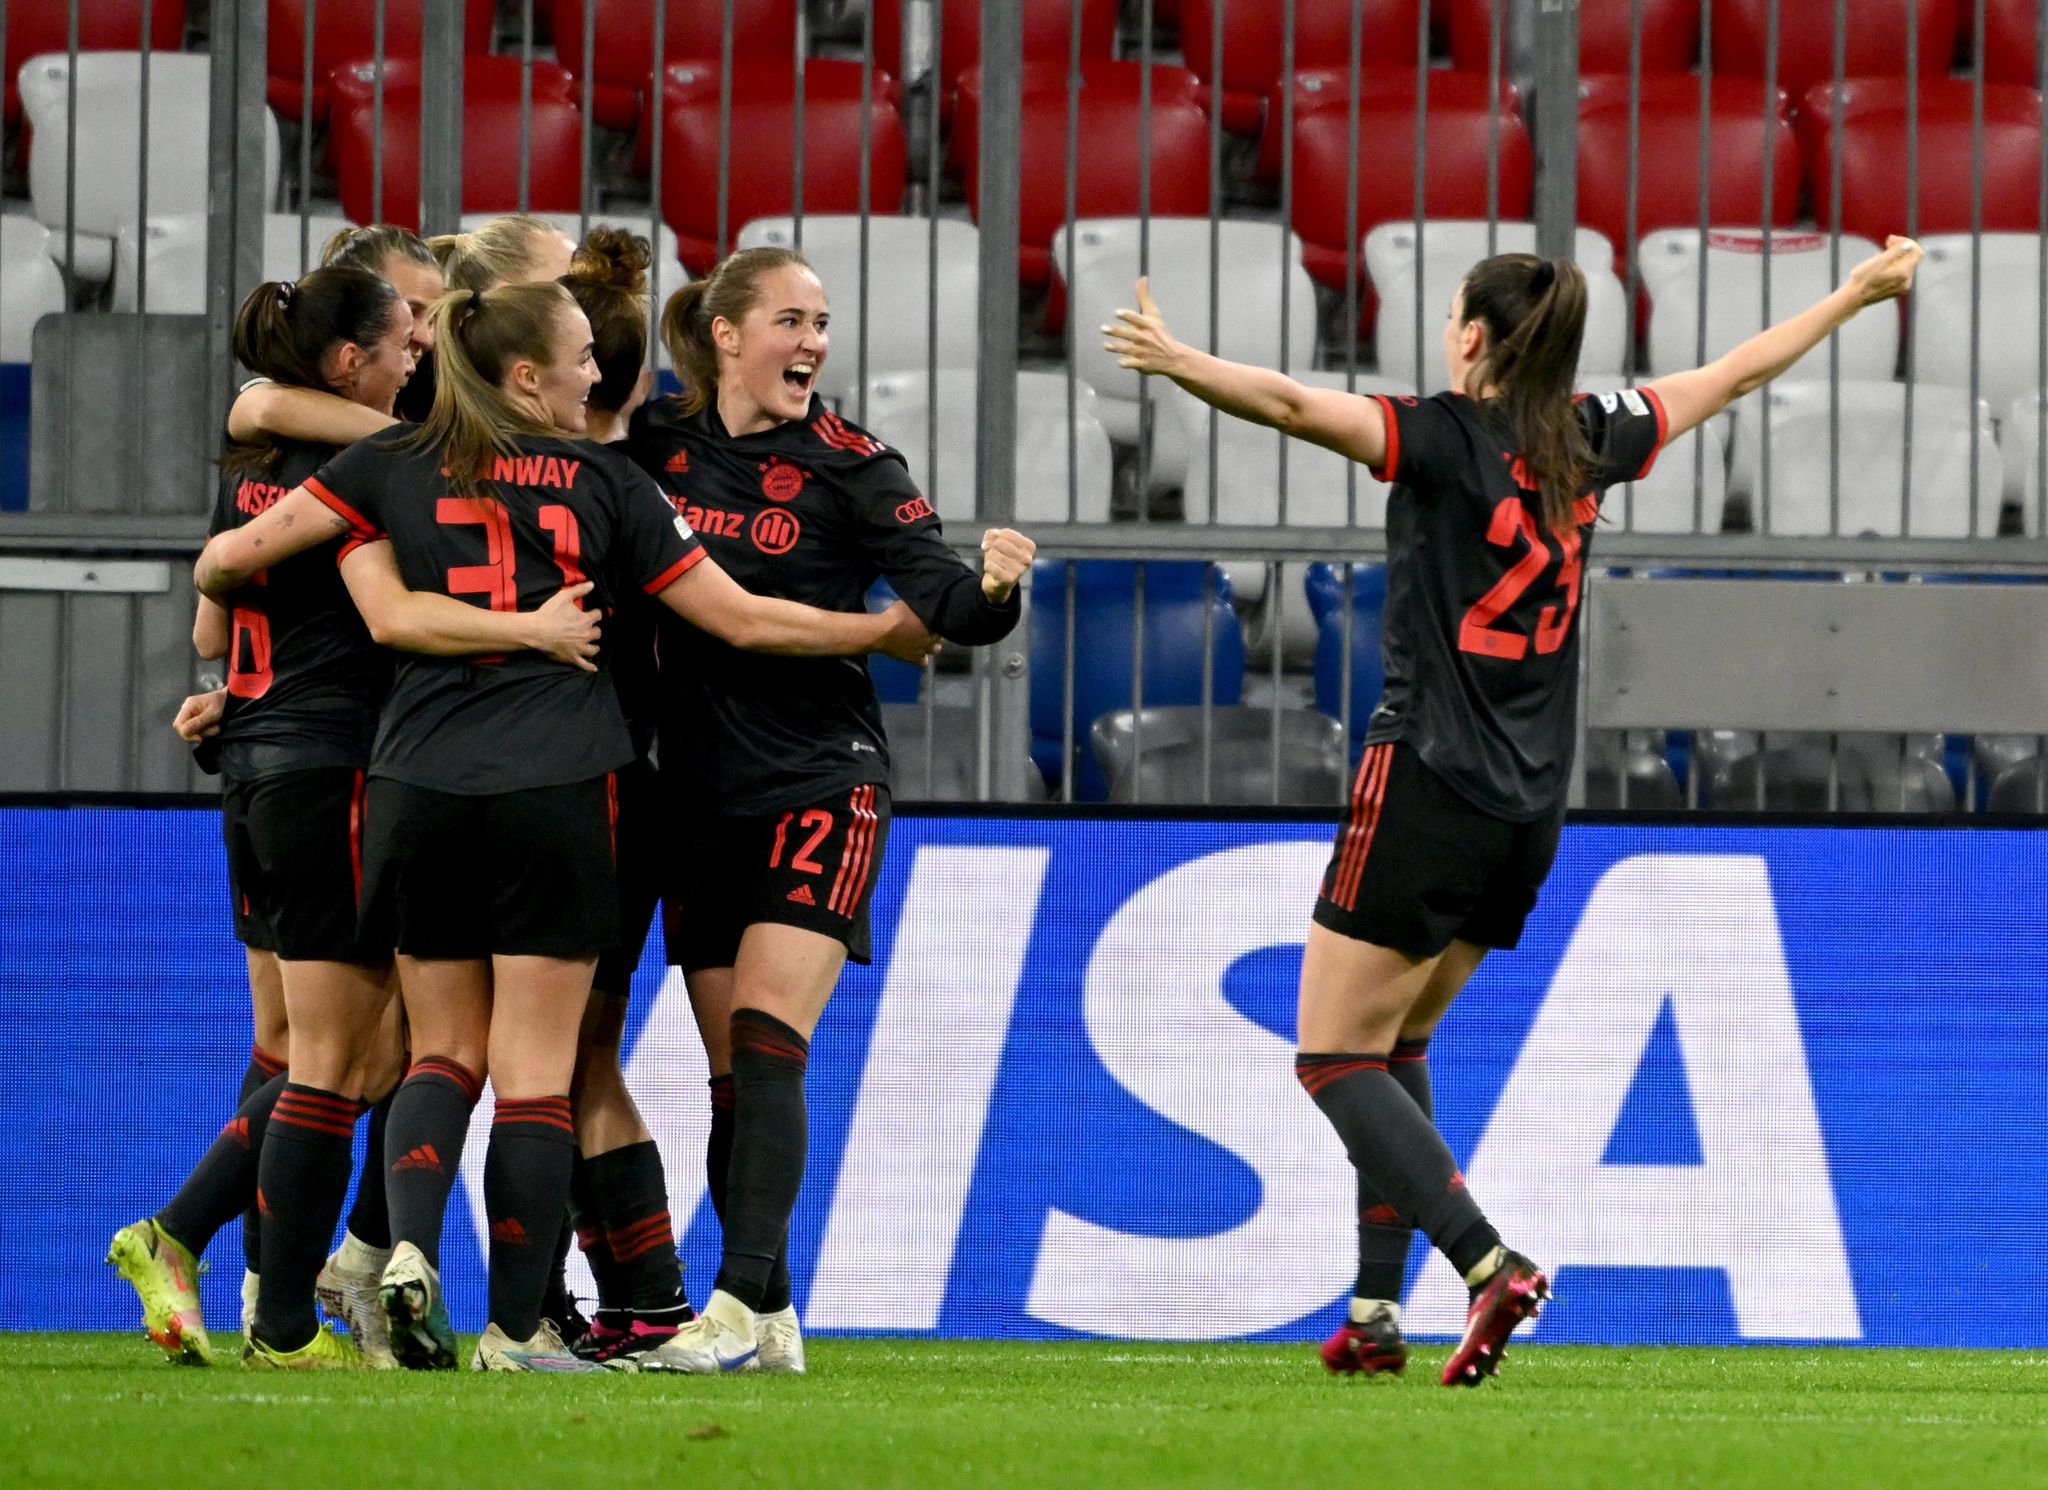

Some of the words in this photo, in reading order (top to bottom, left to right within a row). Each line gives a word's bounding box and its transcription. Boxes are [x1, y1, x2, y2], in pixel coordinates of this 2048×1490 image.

[668, 495, 745, 538] ianz
[436, 497, 586, 664] 31
[769, 809, 833, 874] 12
